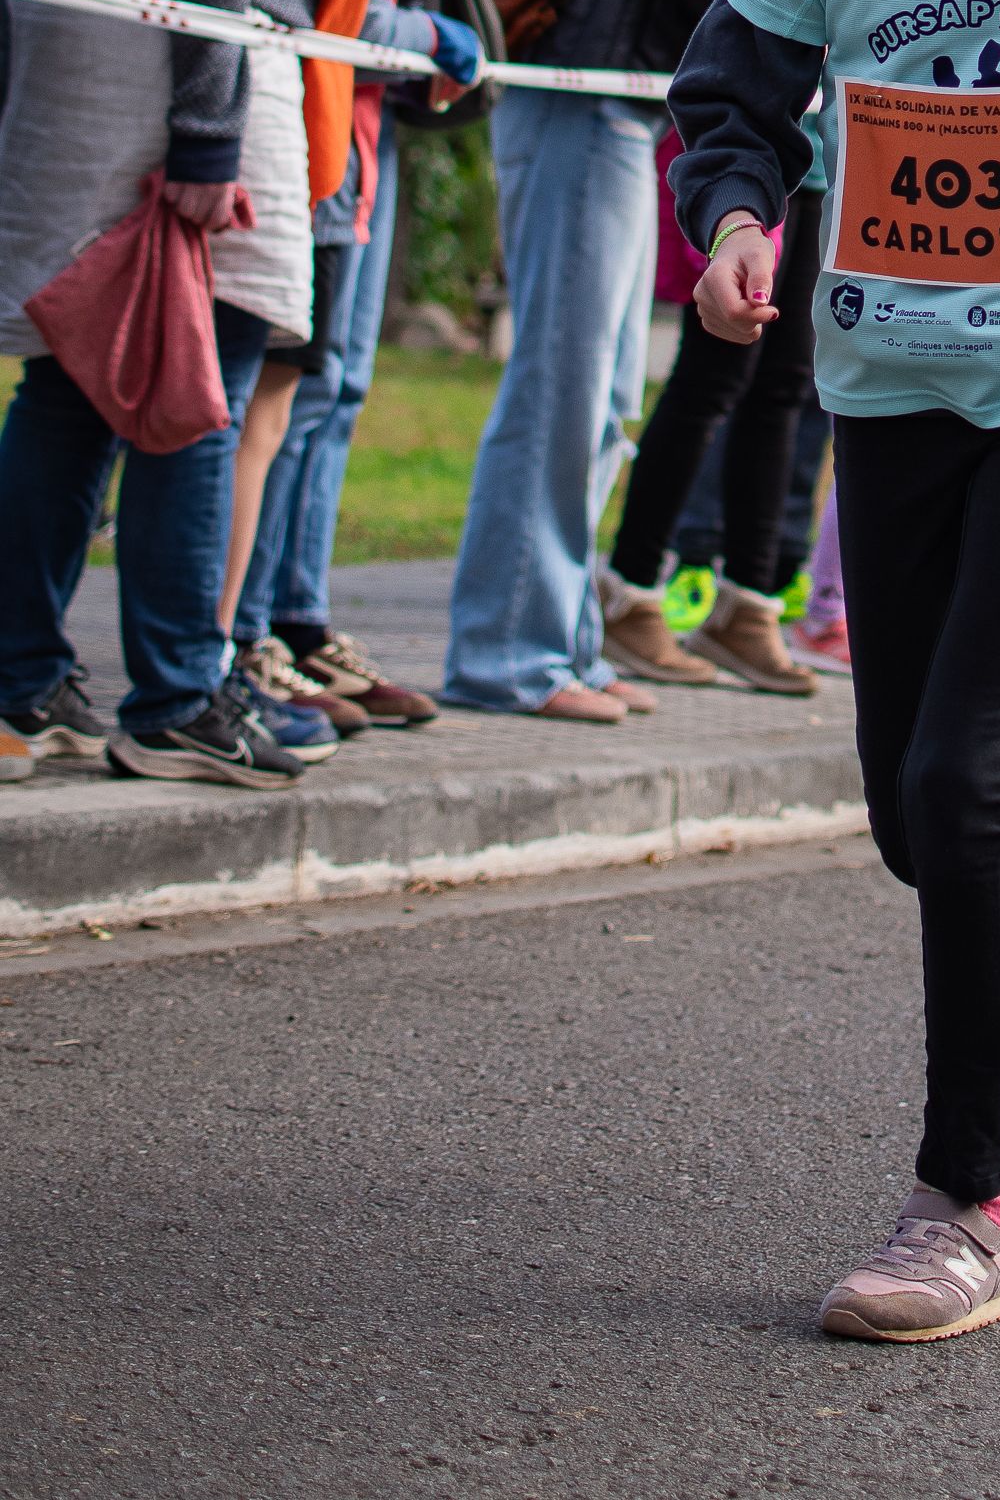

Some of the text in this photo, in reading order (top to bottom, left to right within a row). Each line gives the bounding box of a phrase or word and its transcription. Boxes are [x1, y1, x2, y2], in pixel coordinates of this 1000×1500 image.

[849, 93, 861, 104] IX
[863, 96, 892, 109] MILLA
[895, 99, 956, 116] SOLIDÀRIA
[959, 105, 979, 116] DE
[852, 113, 901, 129] BENJAMINS
[903, 120, 923, 131] 800
[926, 124, 936, 133] M
[939, 123, 998, 136] (NASCUTS
[895, 309, 936, 318] Viladecans
[943, 1244, 990, 1292] N
